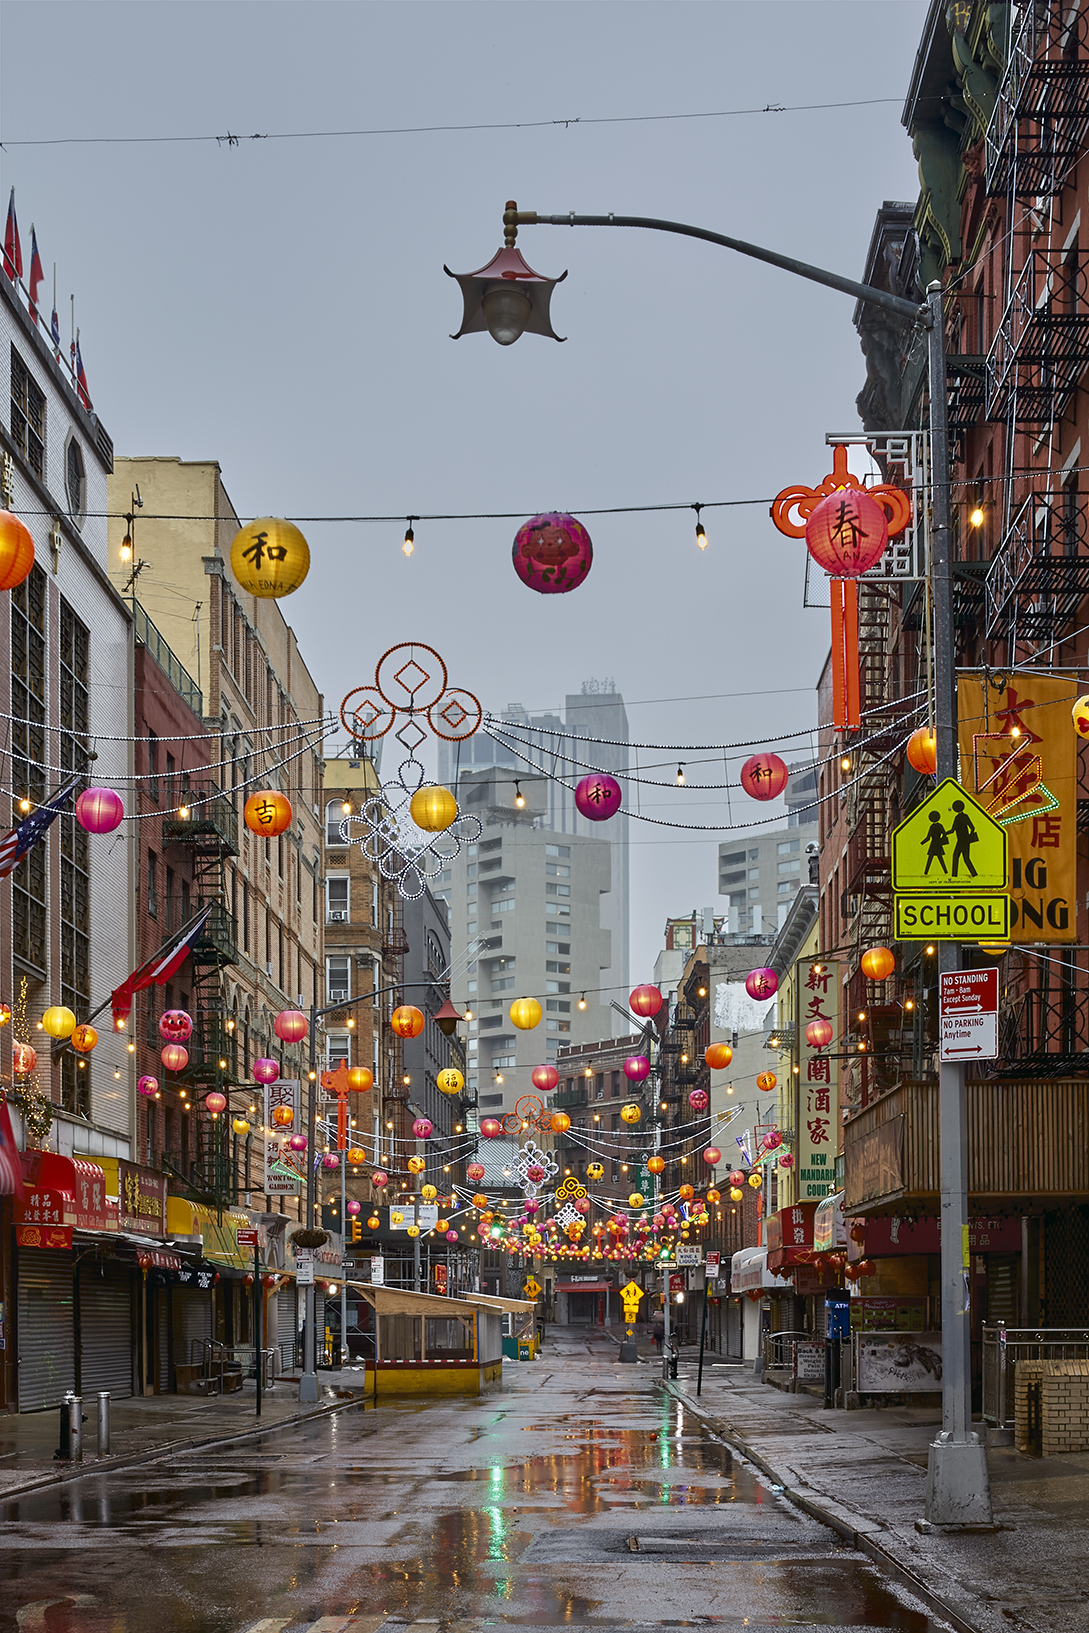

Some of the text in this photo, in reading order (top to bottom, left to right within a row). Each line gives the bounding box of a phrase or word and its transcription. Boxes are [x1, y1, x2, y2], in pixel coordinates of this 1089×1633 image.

[829, 500, 869, 548] 春
[241, 531, 288, 571] 和
[749, 762, 773, 783] 和
[588, 783, 611, 804] 和
[254, 800, 276, 825] 吉
[903, 904, 1001, 926] SCHOOL
[943, 973, 989, 986] NO STANDING
[943, 987, 955, 996] 7am
[958, 986, 971, 994] 8am
[943, 994, 981, 1005] Except Sunday
[943, 1017, 984, 1029] NO PARKING
[943, 1030, 971, 1041] Anytime
[804, 964, 834, 1146] 新文閣酒家
[811, 1153, 827, 1166] NEW
[807, 1183, 831, 1197] COURT
